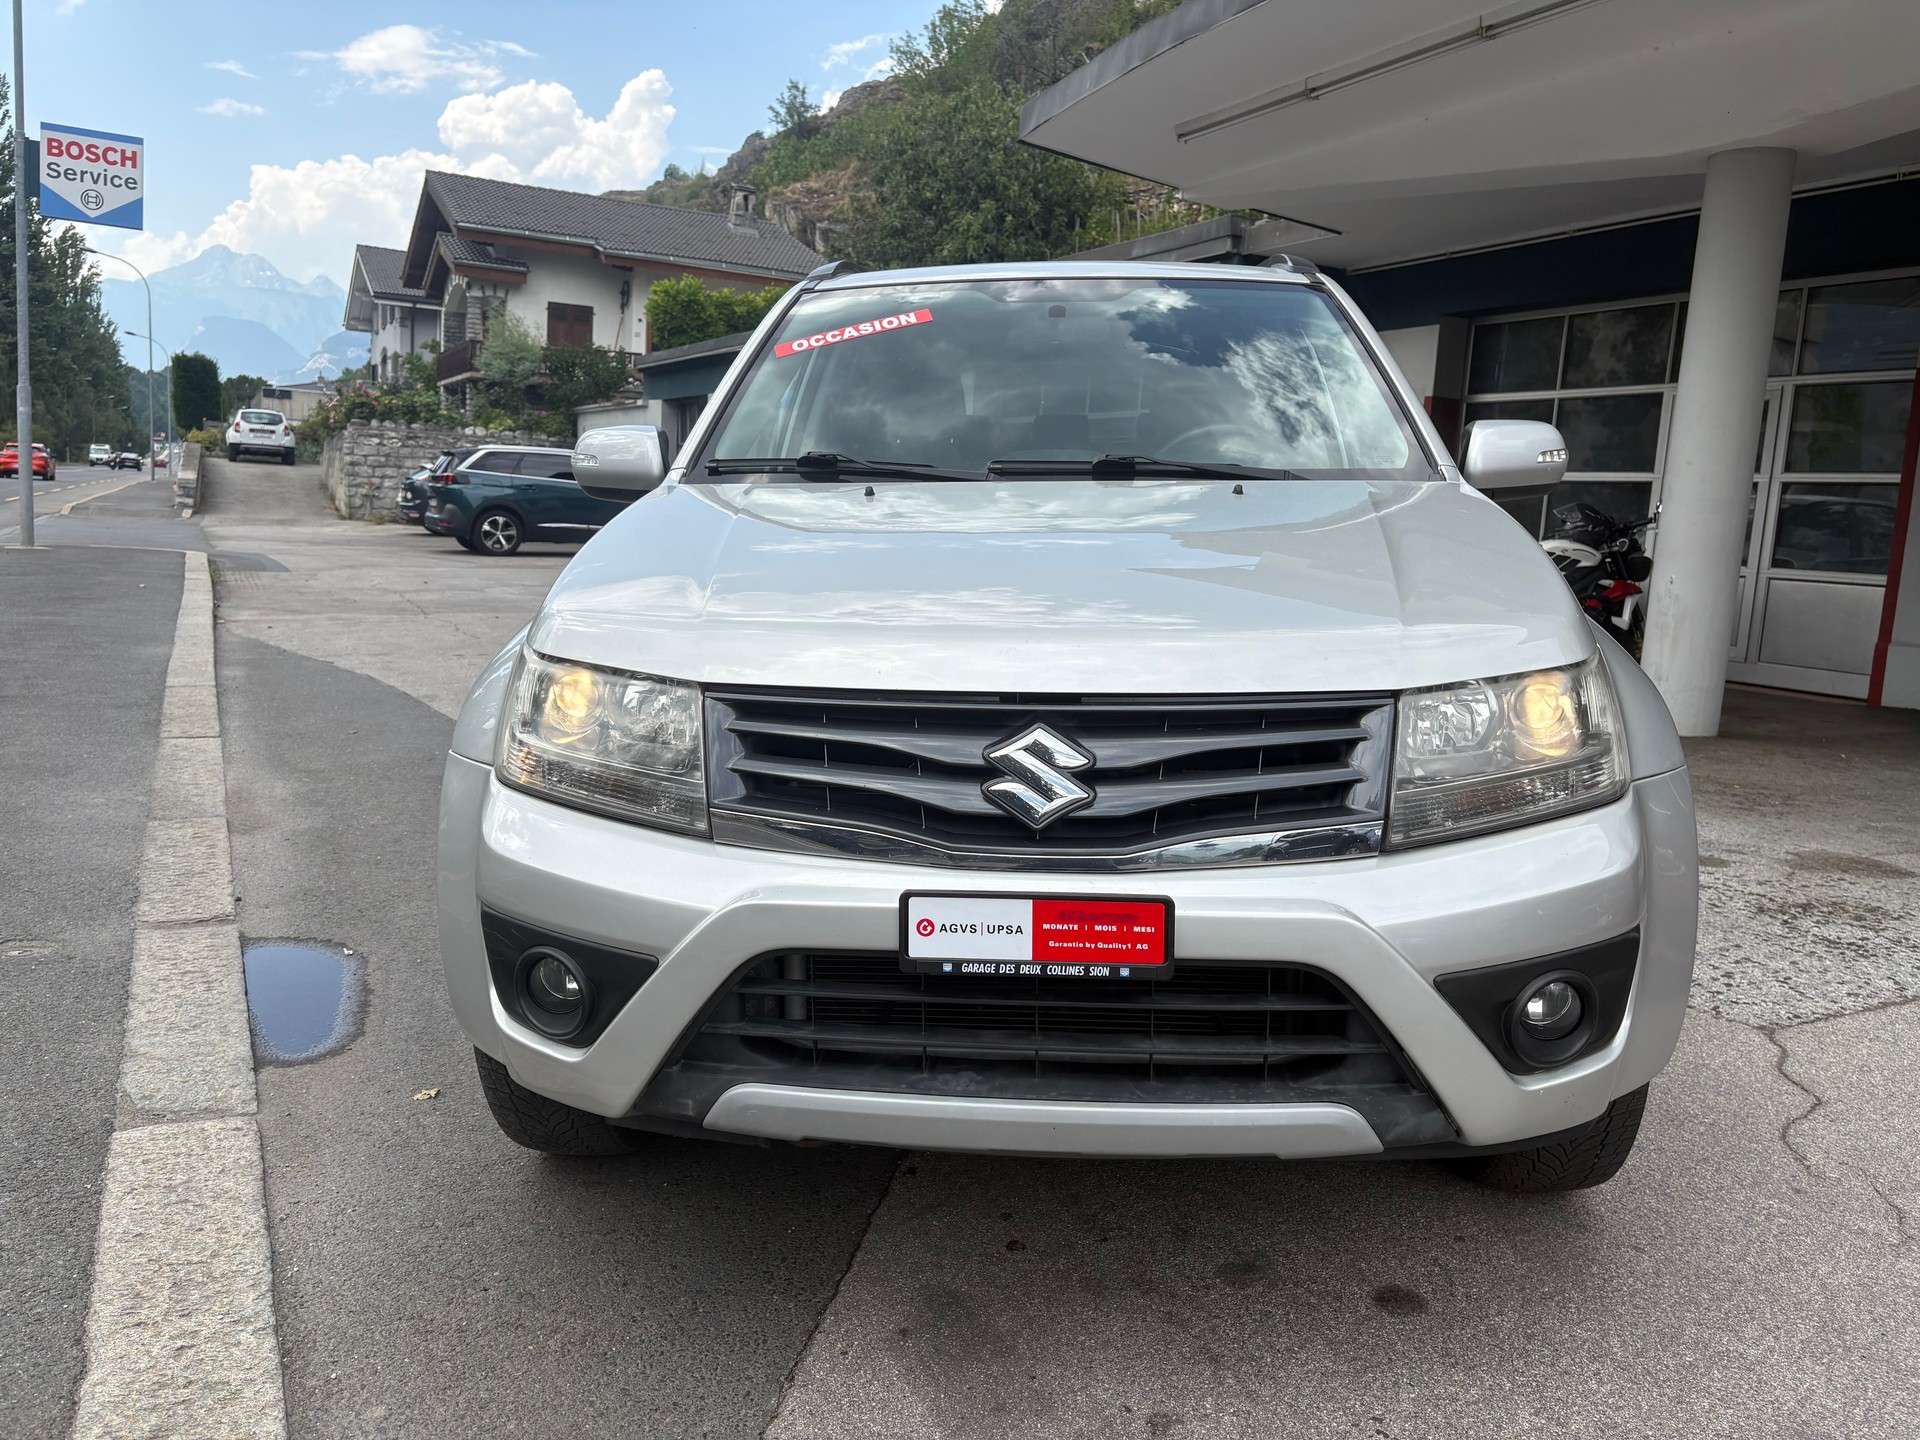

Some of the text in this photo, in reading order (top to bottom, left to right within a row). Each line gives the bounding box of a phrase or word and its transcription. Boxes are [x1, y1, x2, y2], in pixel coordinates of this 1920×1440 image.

[46, 137, 138, 169] BOSCH
[46, 161, 139, 191] Service
[791, 312, 918, 352] OCCASION
[939, 923, 1024, 935] AGVS UPSA
[1042, 923, 1079, 931] MONATE
[1048, 940, 1084, 948] Garantie
[1085, 941, 1096, 949] by
[1097, 942, 1132, 950] Quality1
[961, 963, 996, 973] GARAGE
[999, 964, 1016, 974] DES
[1019, 964, 1042, 975] DEUX
[1046, 965, 1085, 976] COLLINES
[1089, 966, 1110, 977] SION
